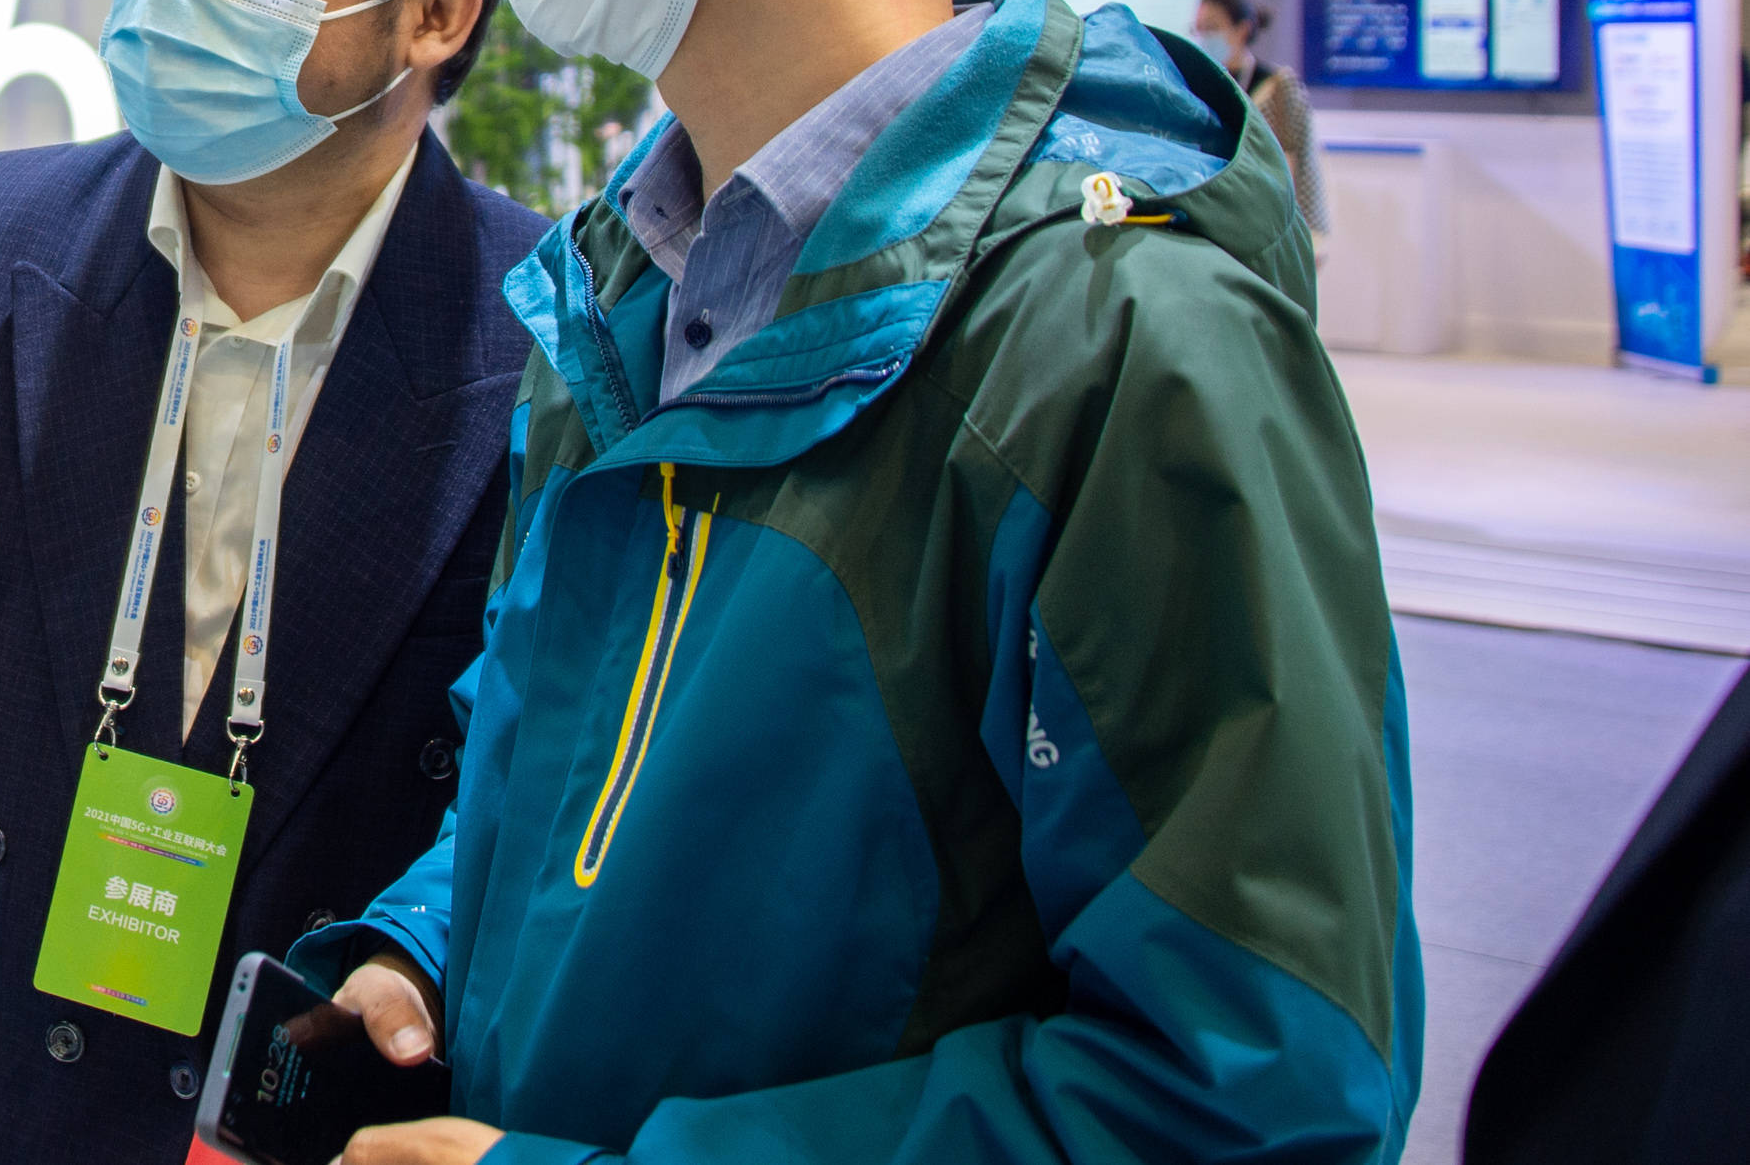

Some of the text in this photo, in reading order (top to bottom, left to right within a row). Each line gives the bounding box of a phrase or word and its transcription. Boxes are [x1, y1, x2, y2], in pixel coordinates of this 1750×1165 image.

[84, 806, 227, 857] 2021中国5G+工业互联网大会
[105, 875, 178, 917] 参展商
[88, 904, 181, 945] EXHIBITOR
